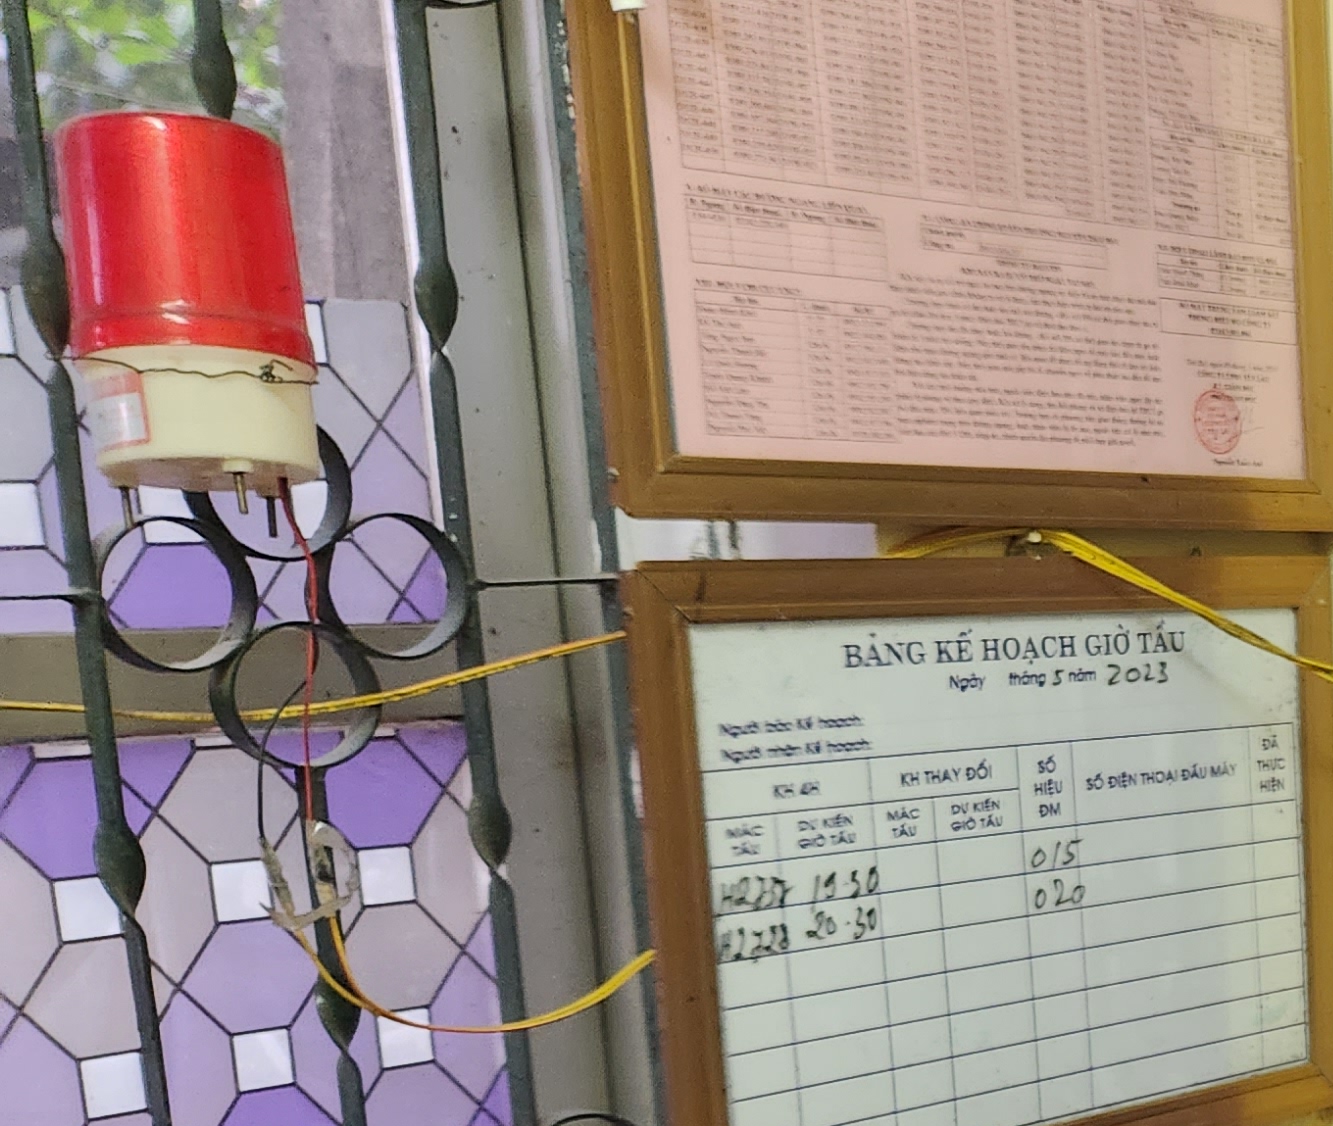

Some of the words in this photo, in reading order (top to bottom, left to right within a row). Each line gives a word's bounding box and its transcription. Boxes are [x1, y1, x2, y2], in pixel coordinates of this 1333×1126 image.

[843, 632, 926, 669] BẢNG
[934, 628, 974, 664] KẾ
[980, 635, 1078, 666] HOẠCH
[1084, 624, 1132, 658] GIỜ
[949, 674, 985, 692] Ngày
[1007, 671, 1047, 689] tháng
[1051, 668, 1063, 687] 5
[1068, 670, 1098, 684] năm
[1106, 661, 1170, 686] 2023
[900, 769, 920, 787] KH
[925, 767, 963, 784] THAY
[1037, 755, 1056, 774] SỐ
[1038, 803, 1062, 819] ĐM
[1030, 838, 1084, 871] 015
[1034, 877, 1087, 910] 020
